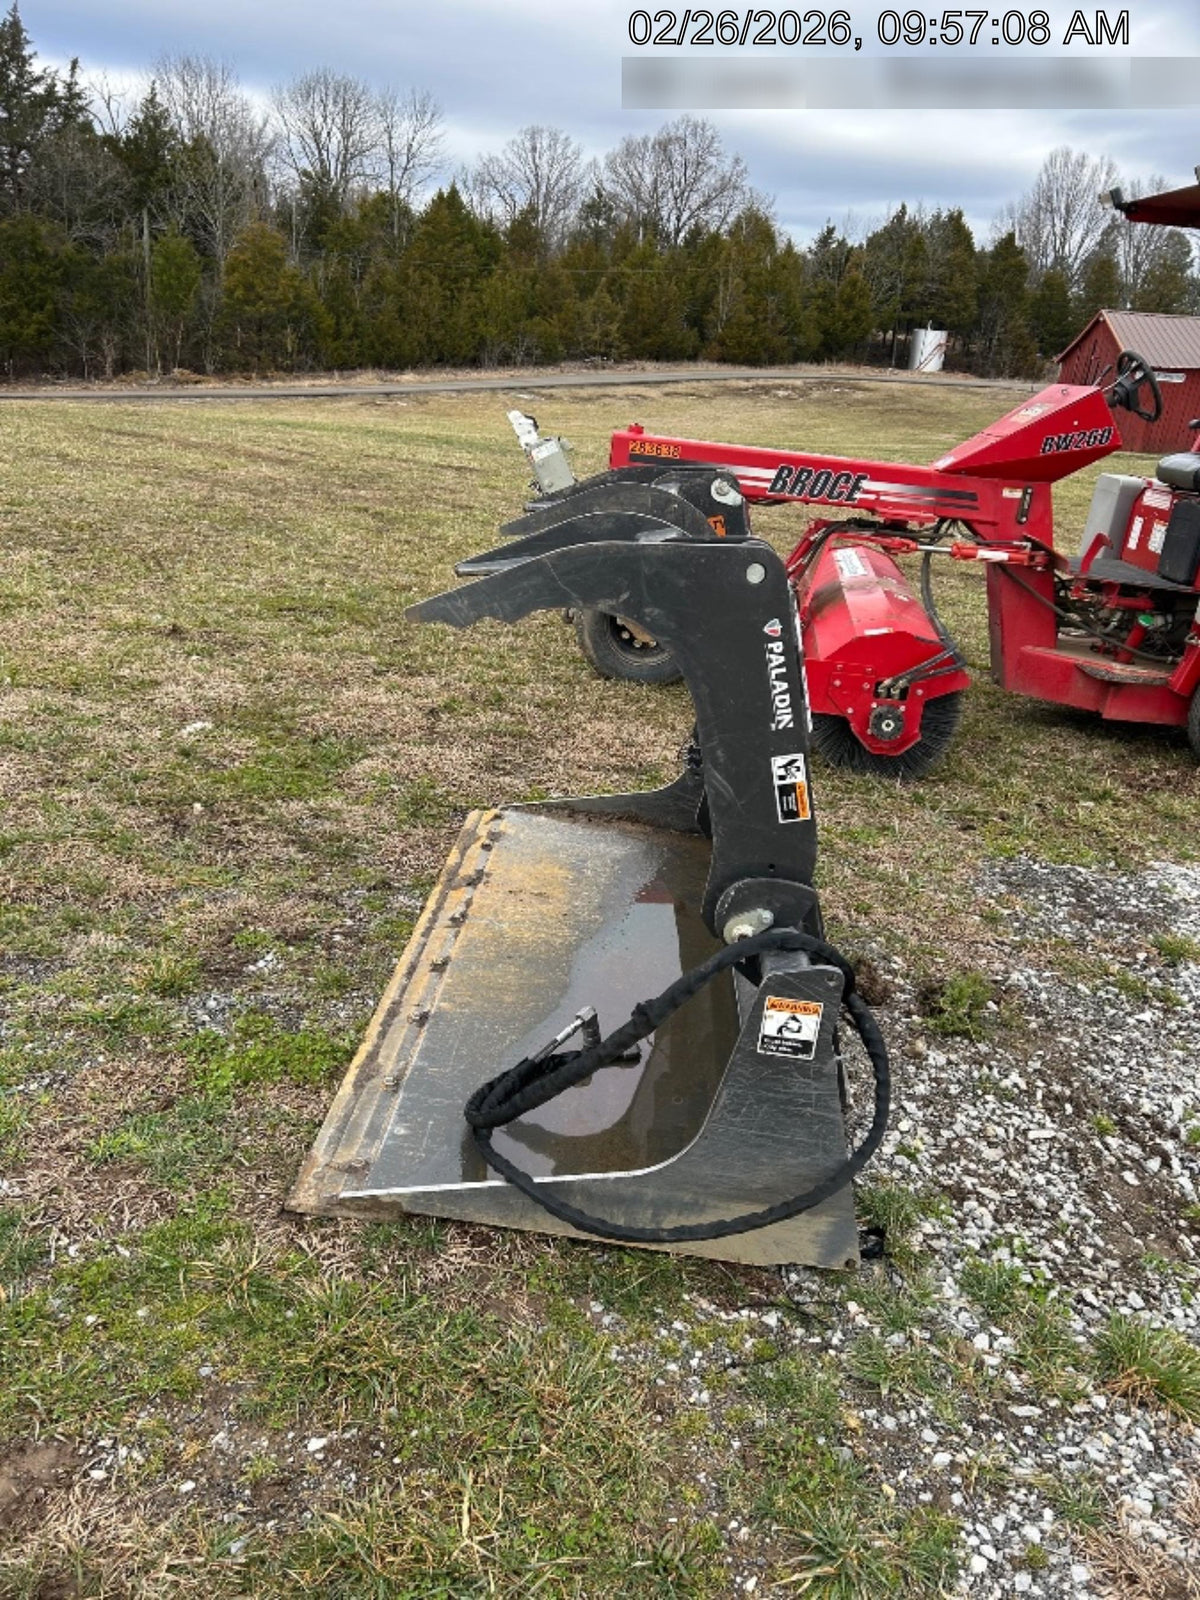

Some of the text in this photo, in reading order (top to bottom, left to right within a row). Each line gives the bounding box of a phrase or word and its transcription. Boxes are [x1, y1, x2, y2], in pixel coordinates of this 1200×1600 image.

[1040, 427, 1114, 455] BW260
[766, 463, 870, 503] BROCE
[767, 641, 794, 730] PALADIN
